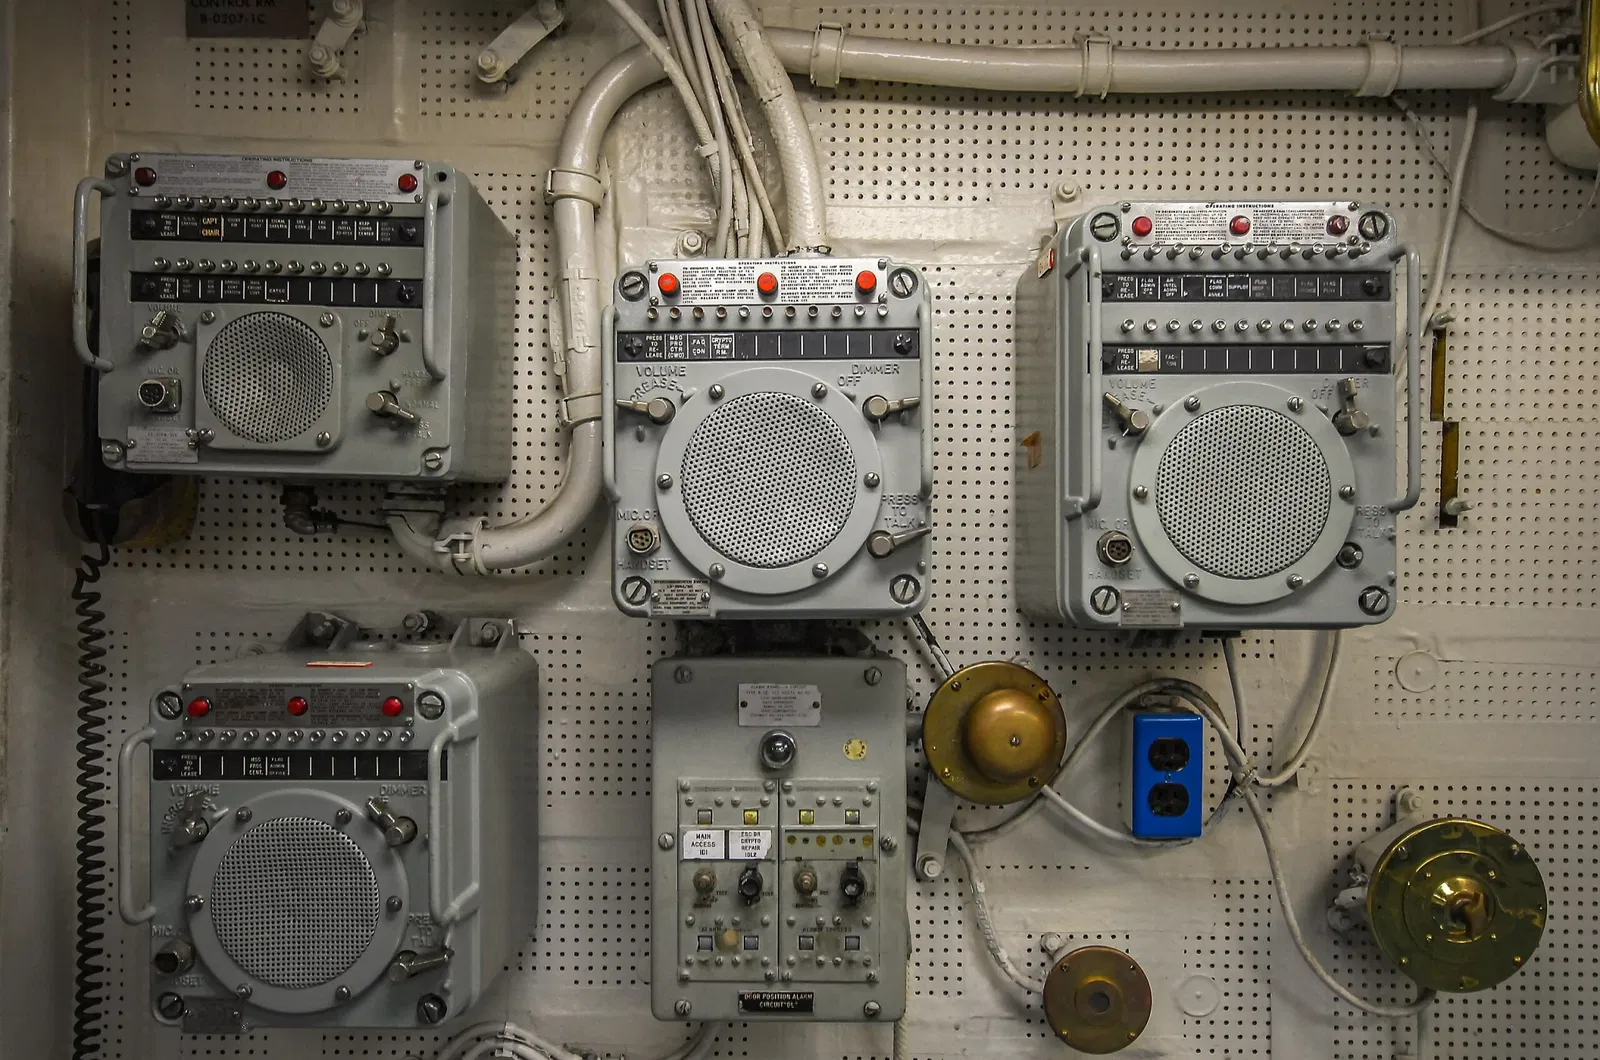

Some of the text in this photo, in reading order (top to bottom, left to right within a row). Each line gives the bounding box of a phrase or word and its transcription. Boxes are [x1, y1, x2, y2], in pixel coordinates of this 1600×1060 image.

[202, 217, 218, 225] CAPT
[201, 228, 220, 237] CHAIR
[636, 365, 688, 378] VOLUME
[851, 363, 900, 375] DIMMER
[836, 375, 862, 388] OFF
[1108, 378, 1156, 389] VOLUME
[1311, 388, 1334, 400] OFF
[891, 505, 908, 517] TO
[616, 558, 673, 571] HANDSET
[1087, 568, 1142, 580] HANDSET
[379, 784, 428, 797] DIMMER
